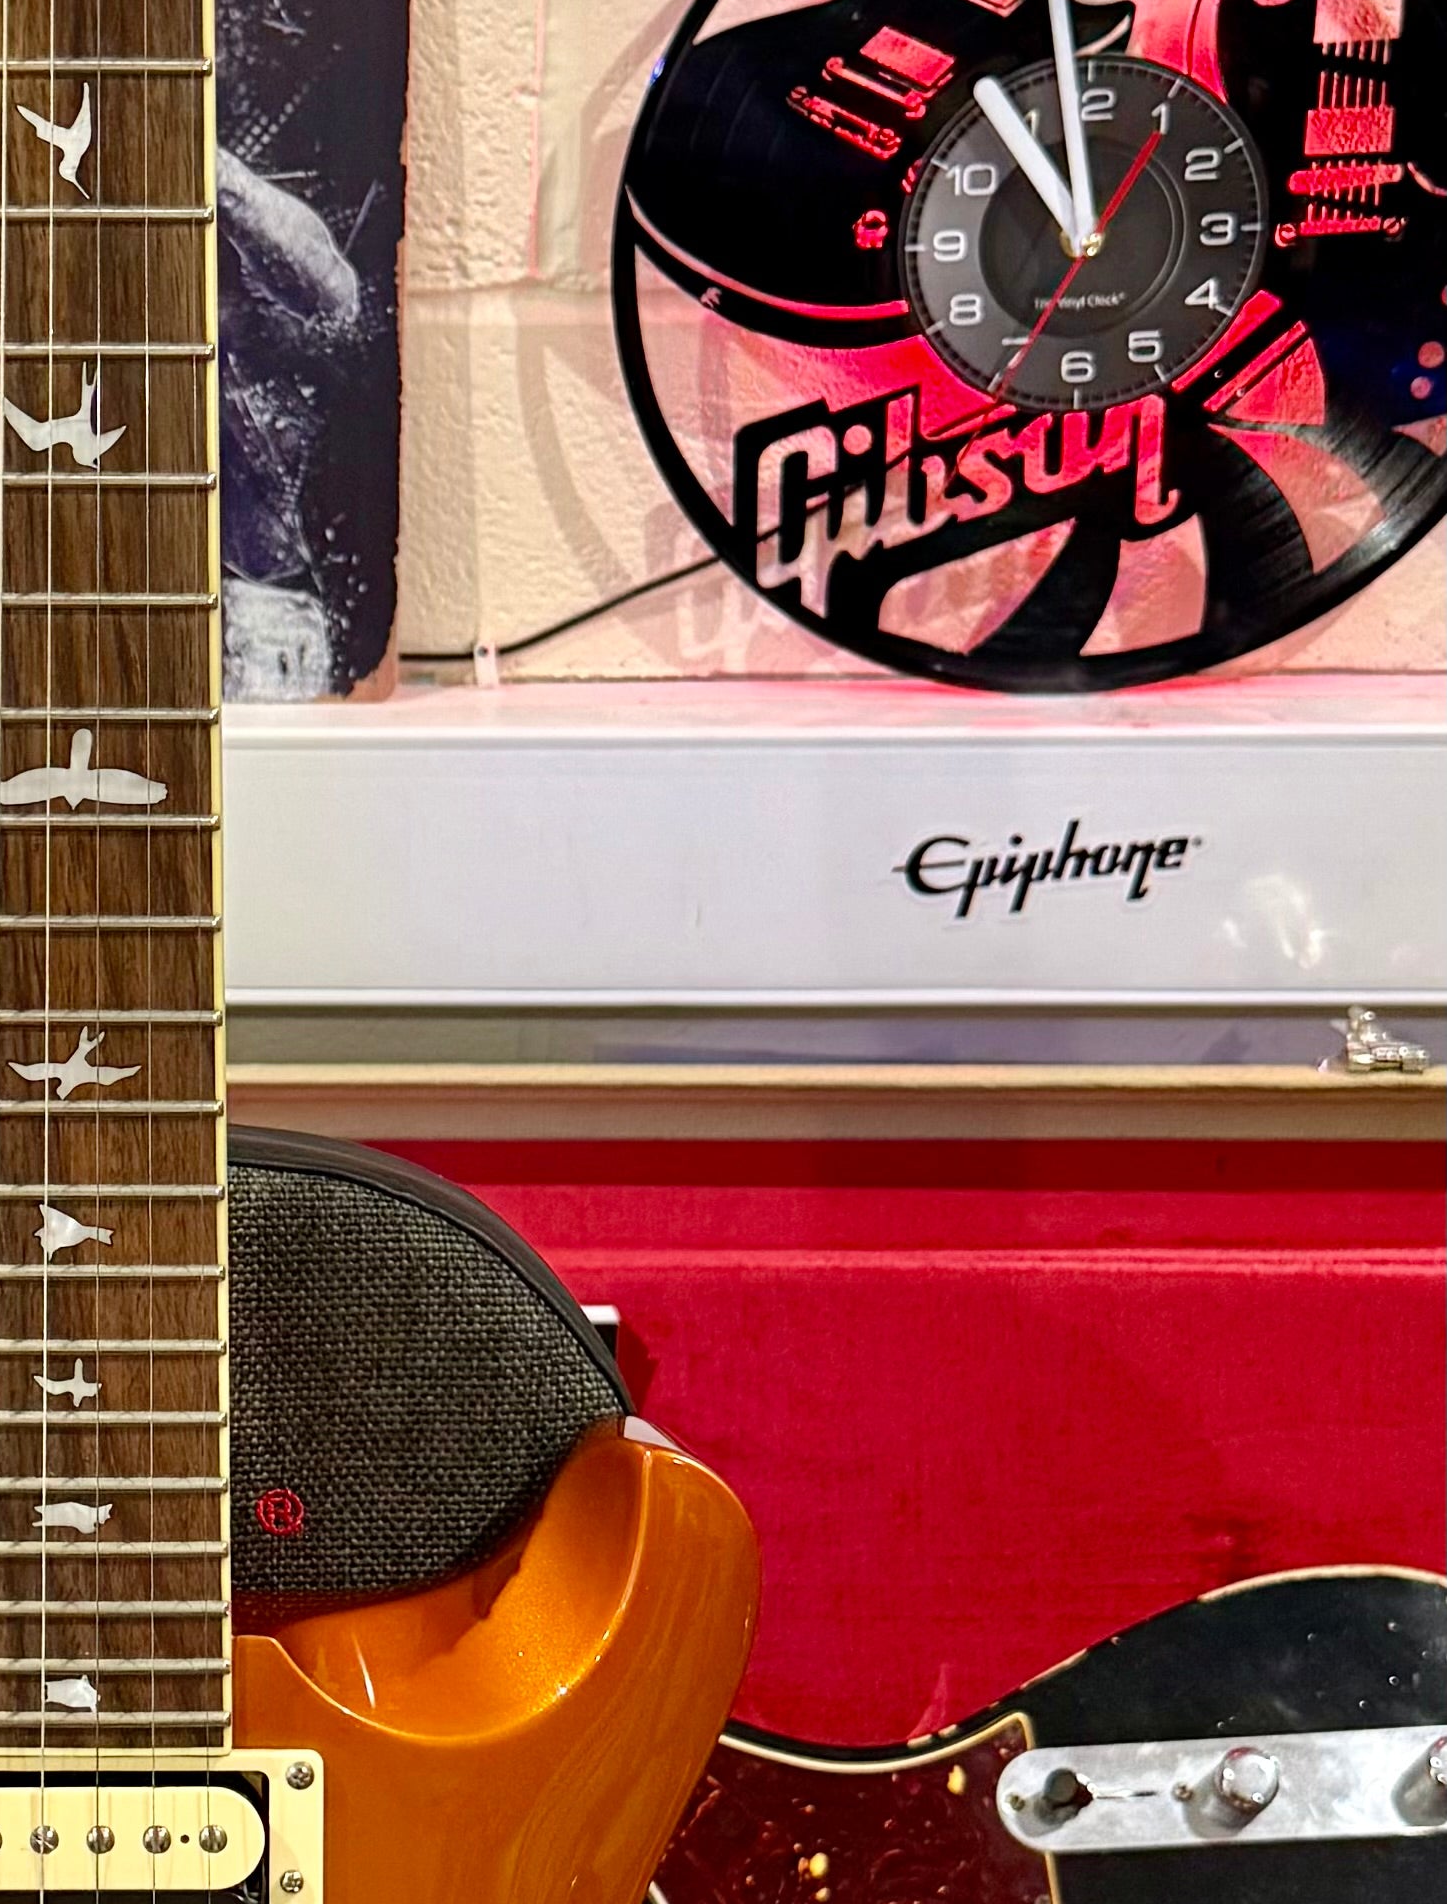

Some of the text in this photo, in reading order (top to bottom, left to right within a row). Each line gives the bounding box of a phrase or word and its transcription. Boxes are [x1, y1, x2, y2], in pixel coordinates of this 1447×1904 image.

[945, 163, 997, 196] 10
[1184, 147, 1222, 181] 2
[932, 230, 966, 262] 9
[1199, 212, 1236, 247] 3
[949, 293, 984, 326] 8
[1184, 277, 1219, 310] 4
[1127, 329, 1164, 363] 5
[1060, 350, 1096, 383] 6
[756, 392, 1182, 619] Gibson
[891, 817, 1191, 919] Epiphone
